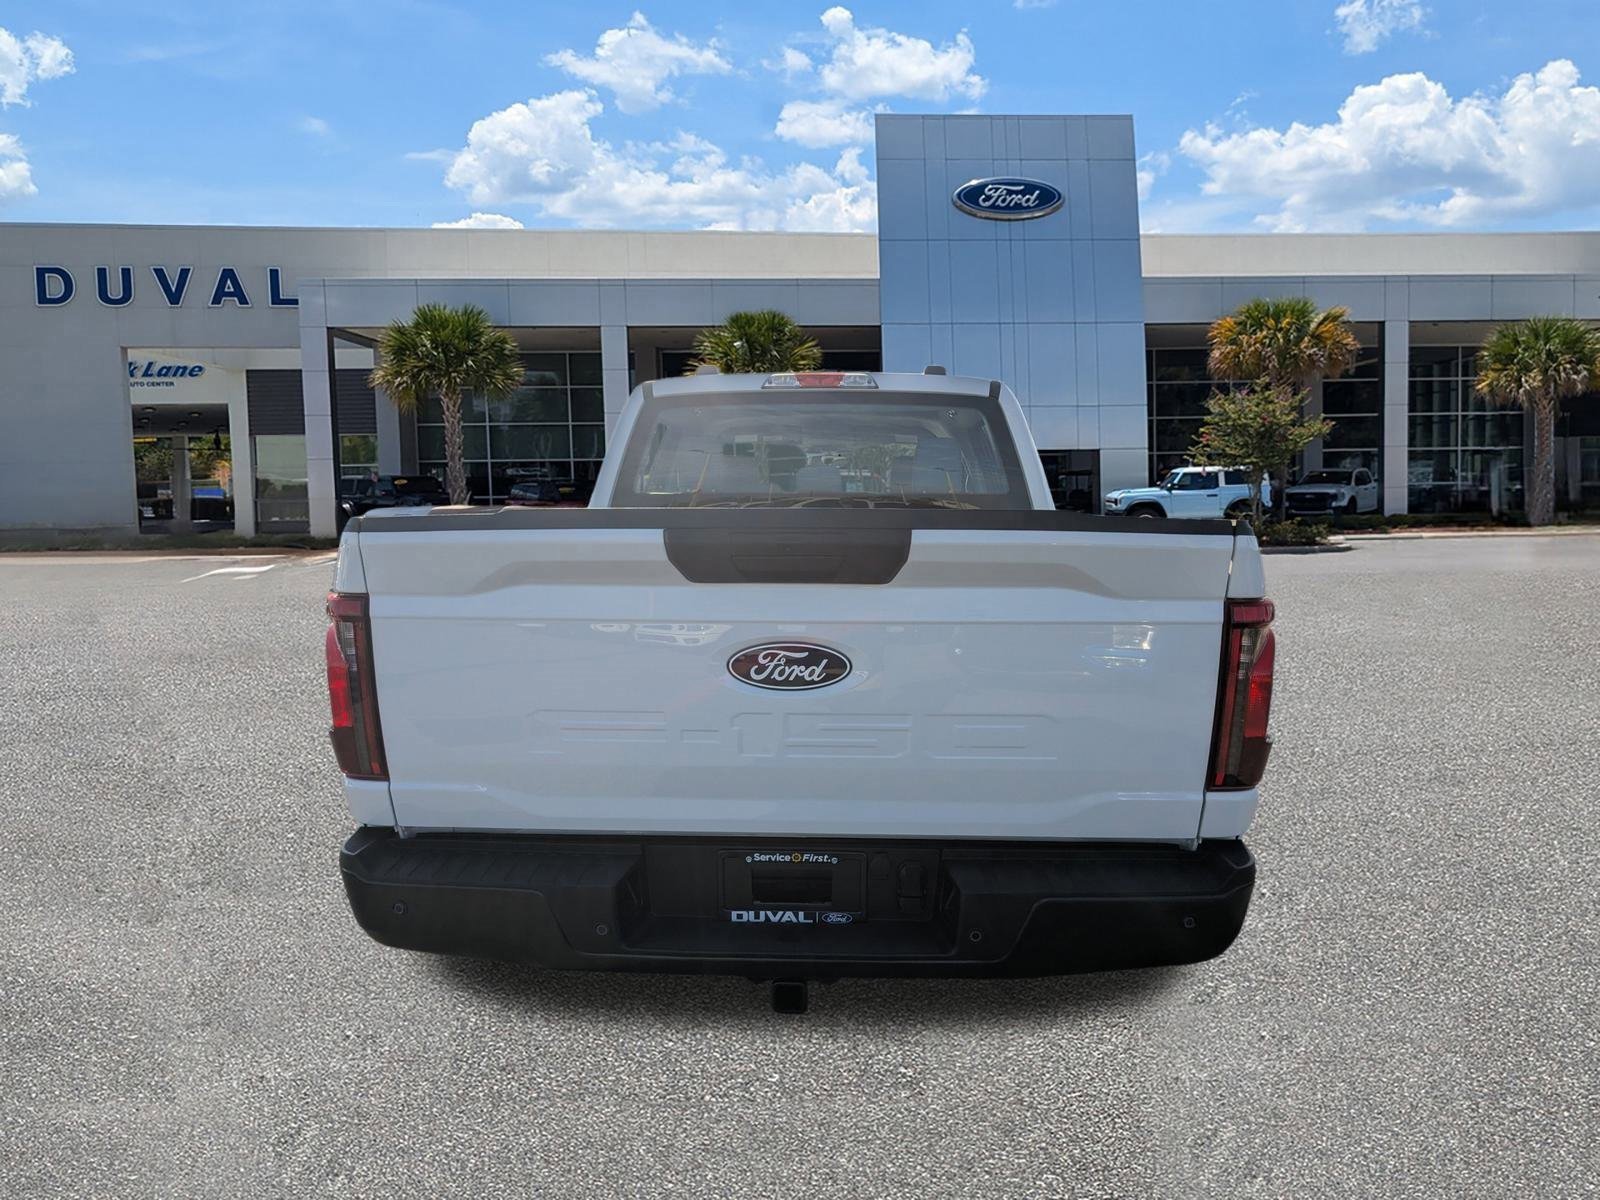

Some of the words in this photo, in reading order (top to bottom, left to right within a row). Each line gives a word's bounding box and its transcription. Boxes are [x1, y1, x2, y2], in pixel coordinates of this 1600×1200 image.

[978, 184, 1040, 207] Ford
[34, 265, 299, 308] DUVAL
[141, 361, 205, 378] Lane
[749, 649, 829, 682] Ford
[753, 852, 791, 863] Service
[802, 853, 831, 863] First.
[731, 910, 813, 924] DUVAL
[825, 913, 848, 923] Ford
